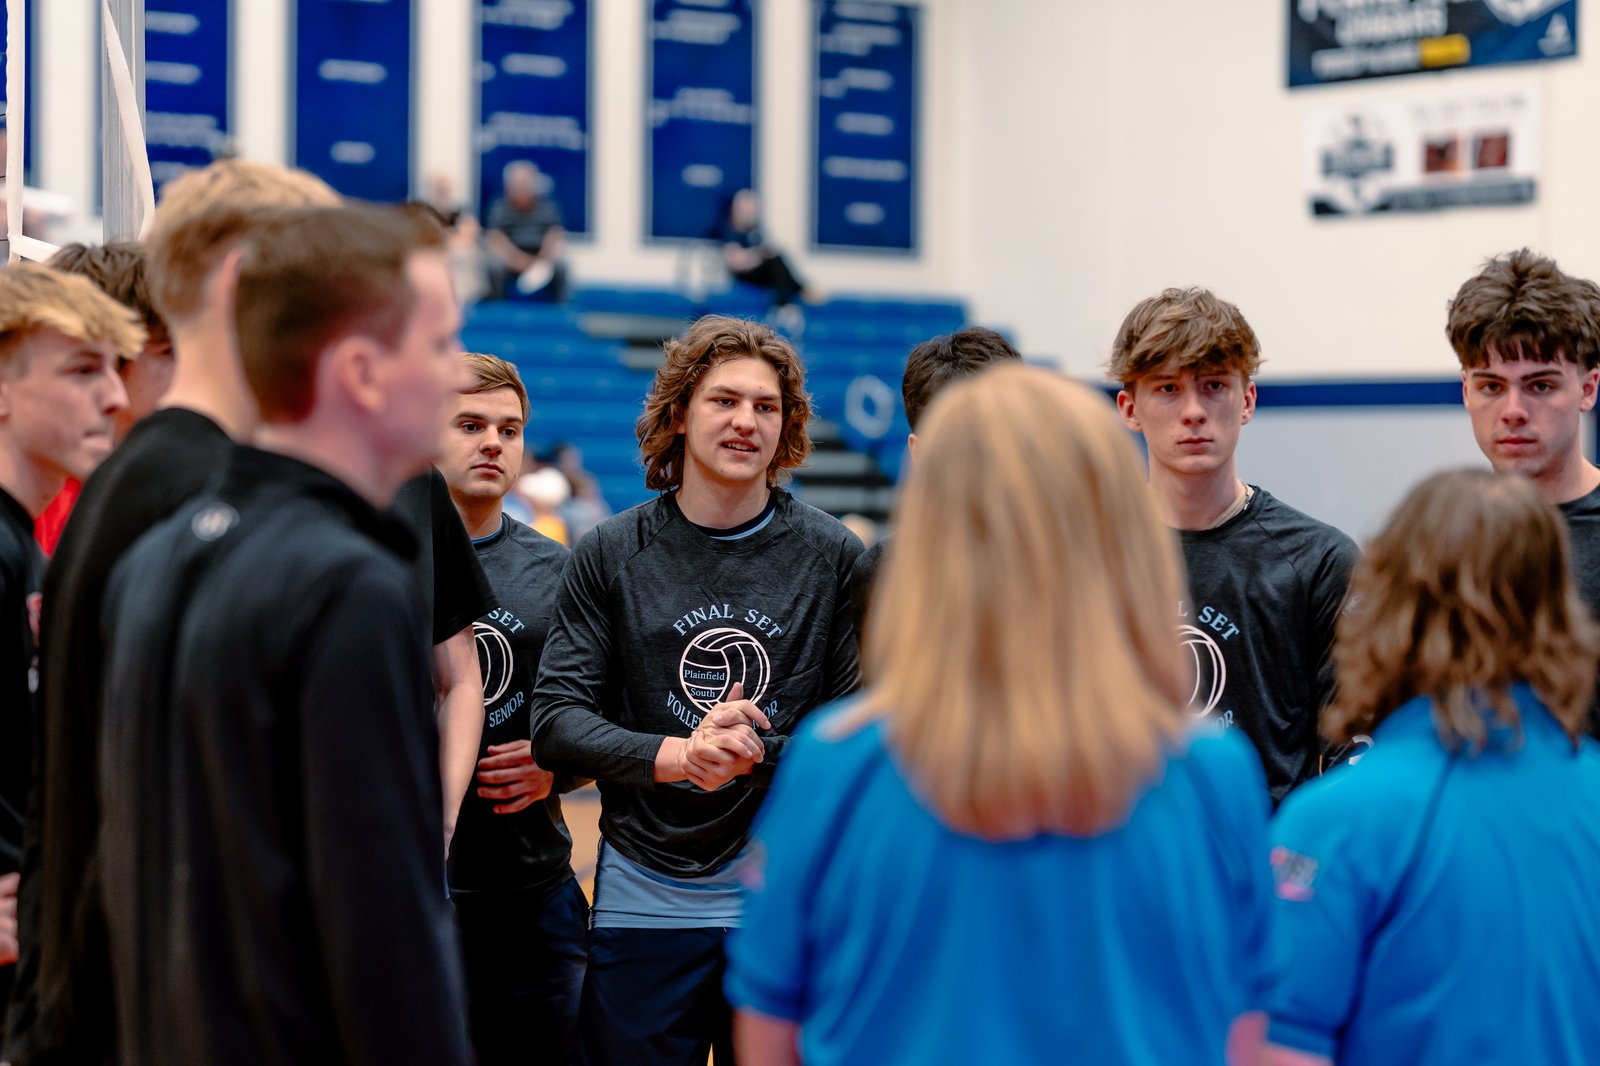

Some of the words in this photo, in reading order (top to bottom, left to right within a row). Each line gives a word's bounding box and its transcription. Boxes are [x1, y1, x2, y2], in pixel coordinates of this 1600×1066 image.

[673, 604, 734, 636] FINAL
[744, 609, 783, 639] SET
[1198, 606, 1240, 640] SET
[684, 669, 725, 681] Plainfield
[488, 690, 525, 728] SENIOR
[690, 687, 716, 698] South
[667, 690, 702, 730] VOLLE
